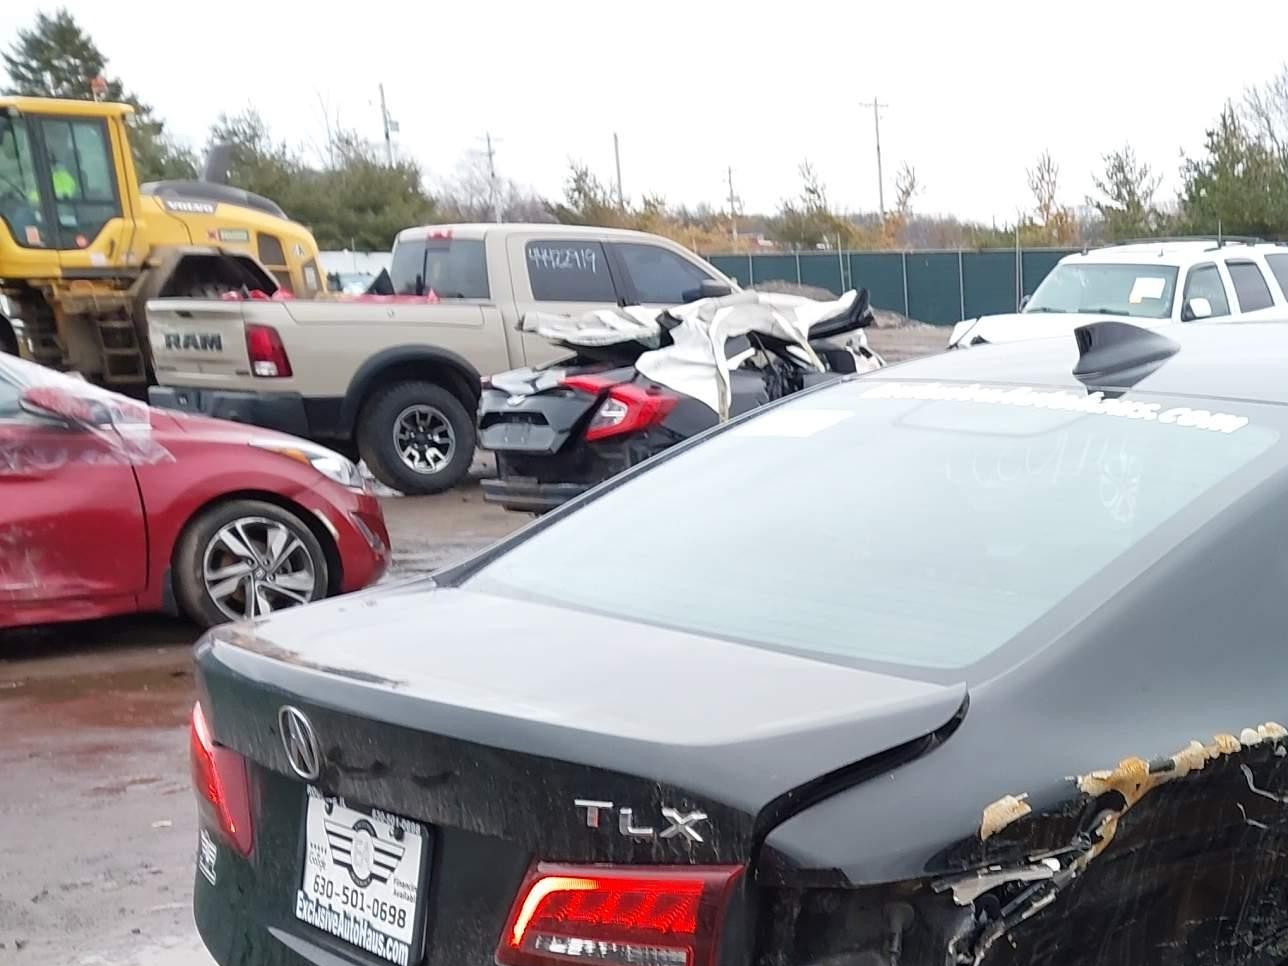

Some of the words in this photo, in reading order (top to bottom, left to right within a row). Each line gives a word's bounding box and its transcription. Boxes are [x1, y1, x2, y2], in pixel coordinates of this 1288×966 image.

[167, 200, 213, 213] VOLVO
[164, 333, 223, 351] RAM
[574, 799, 707, 842] TLX
[313, 875, 407, 928] 630-501-0698
